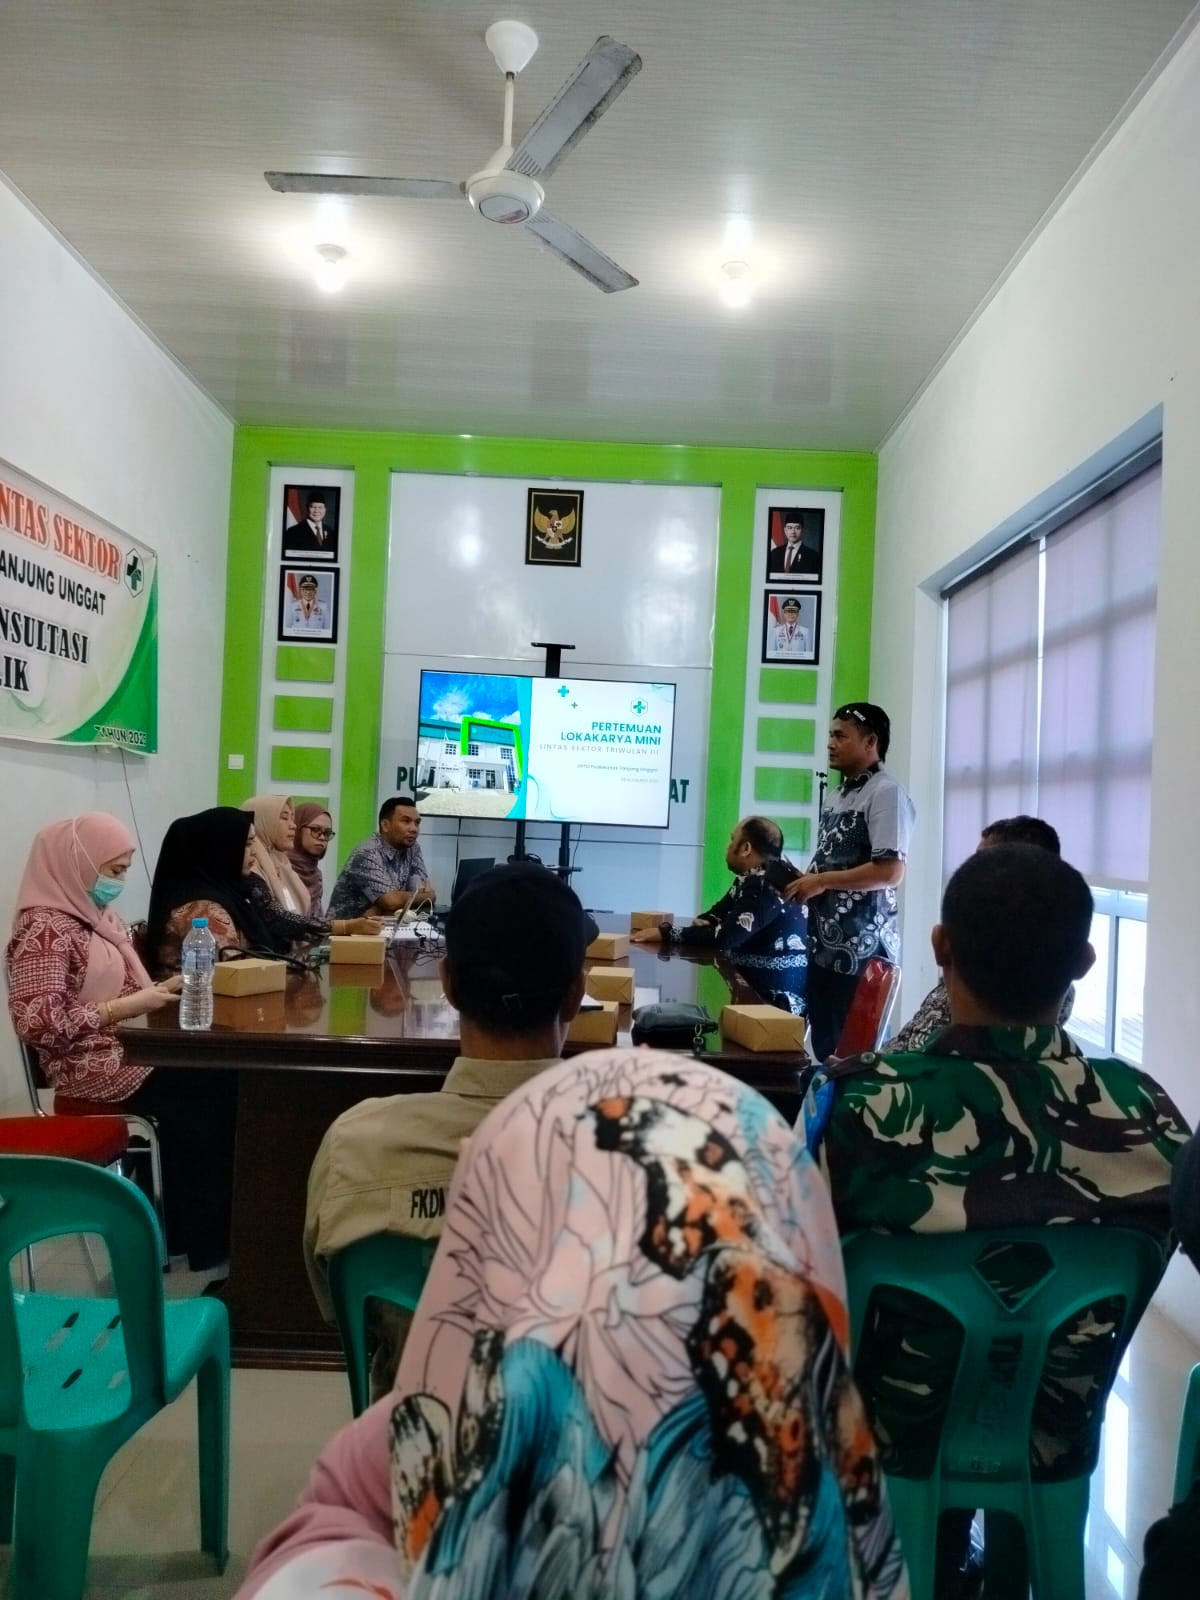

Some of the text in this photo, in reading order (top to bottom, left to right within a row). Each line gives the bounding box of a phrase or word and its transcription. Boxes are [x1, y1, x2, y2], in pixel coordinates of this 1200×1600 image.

[54, 513, 120, 580] SEKTOR
[59, 575, 106, 615] UNGGAT
[0, 655, 29, 691] IK
[561, 732, 661, 745] LOKAKARYA MINI
[592, 722, 662, 734] PERTEMUAN
